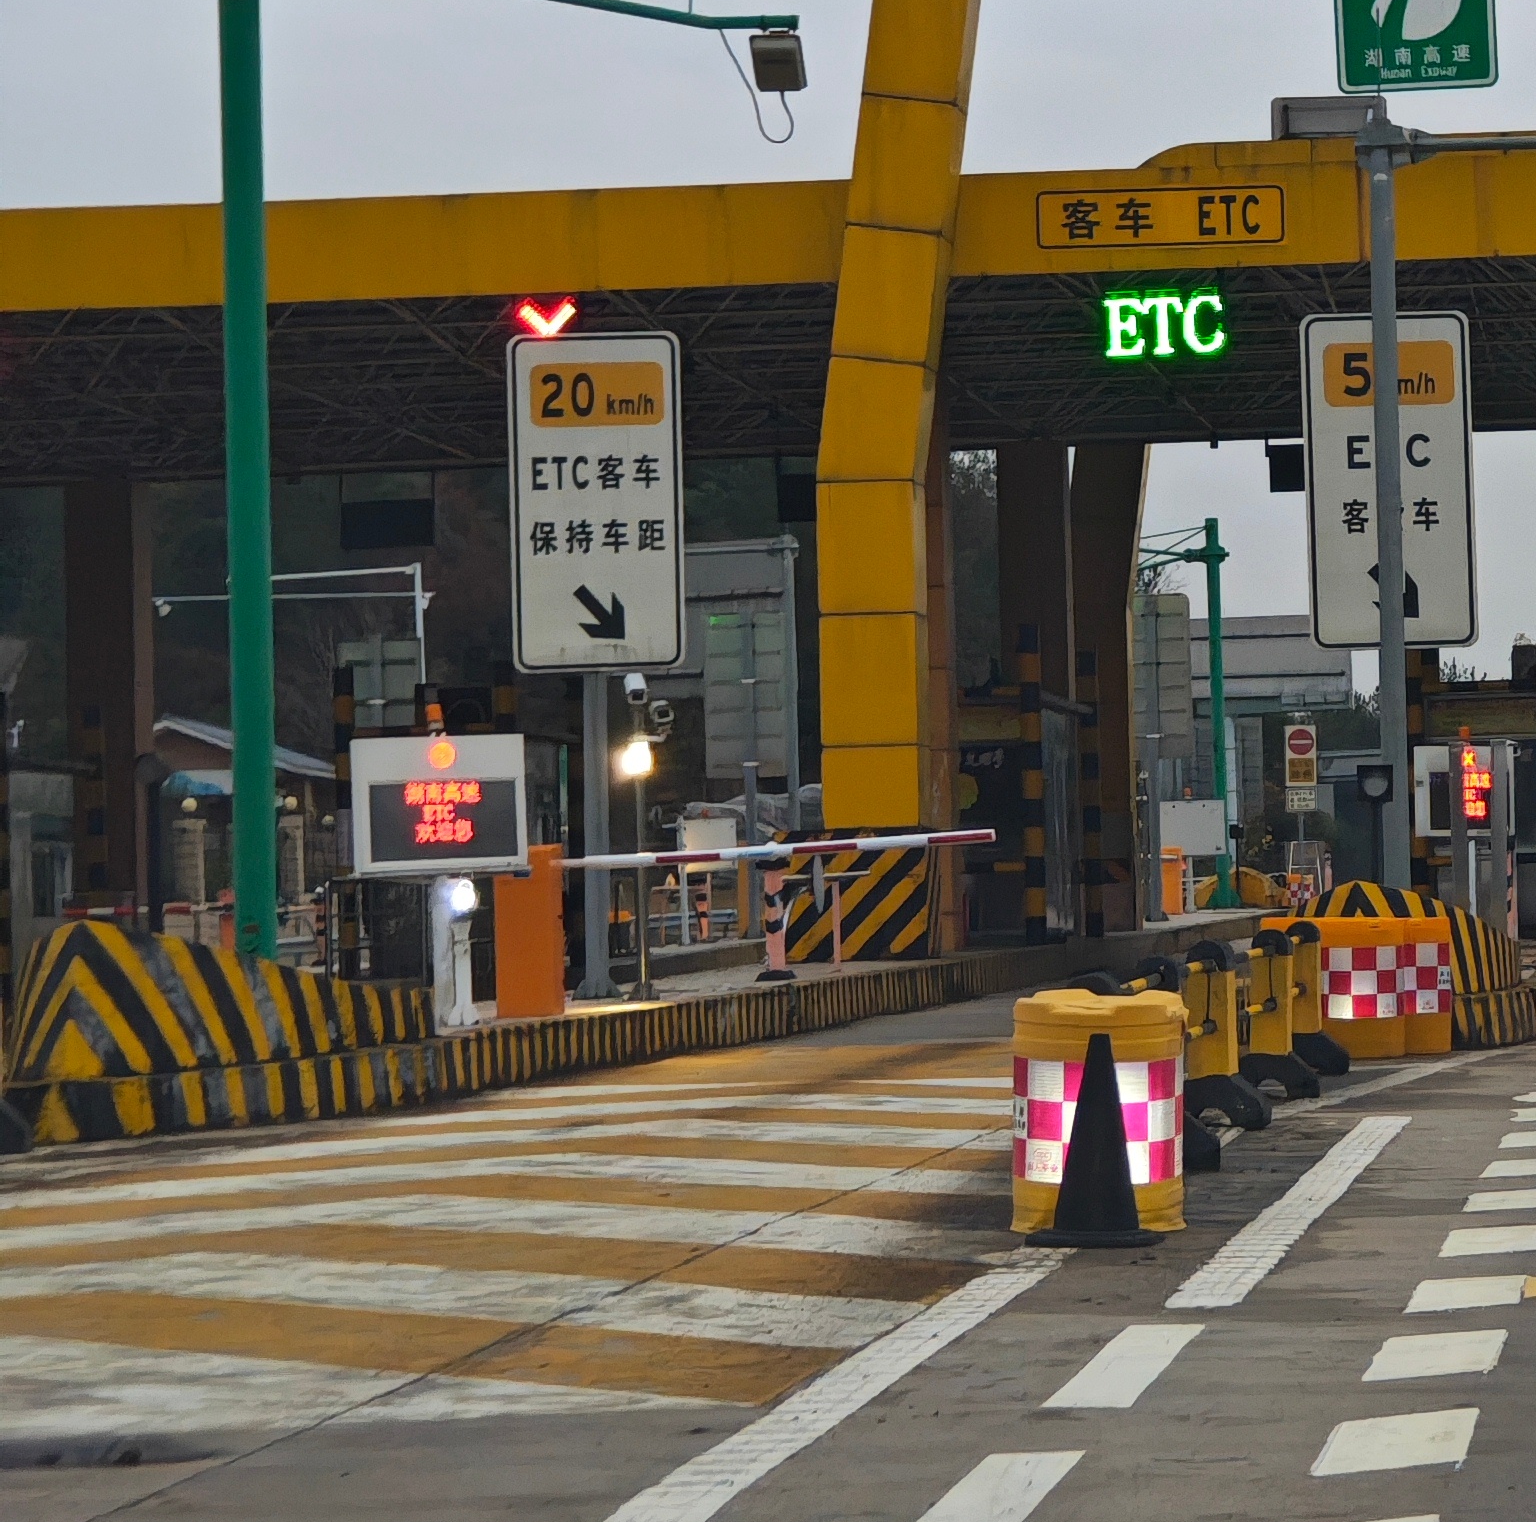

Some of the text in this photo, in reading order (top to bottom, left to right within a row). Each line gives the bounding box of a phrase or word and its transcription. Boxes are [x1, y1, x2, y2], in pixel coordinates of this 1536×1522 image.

[1364, 44, 1471, 67] 湖南高速
[1061, 194, 1261, 240] 客车 ETC
[1102, 288, 1227, 359] ETC
[541, 372, 656, 419] 20 km/h
[1342, 352, 1372, 398] 5
[1346, 432, 1432, 470] EC
[1341, 496, 1440, 535] 客车
[530, 519, 667, 556] 保持车距
